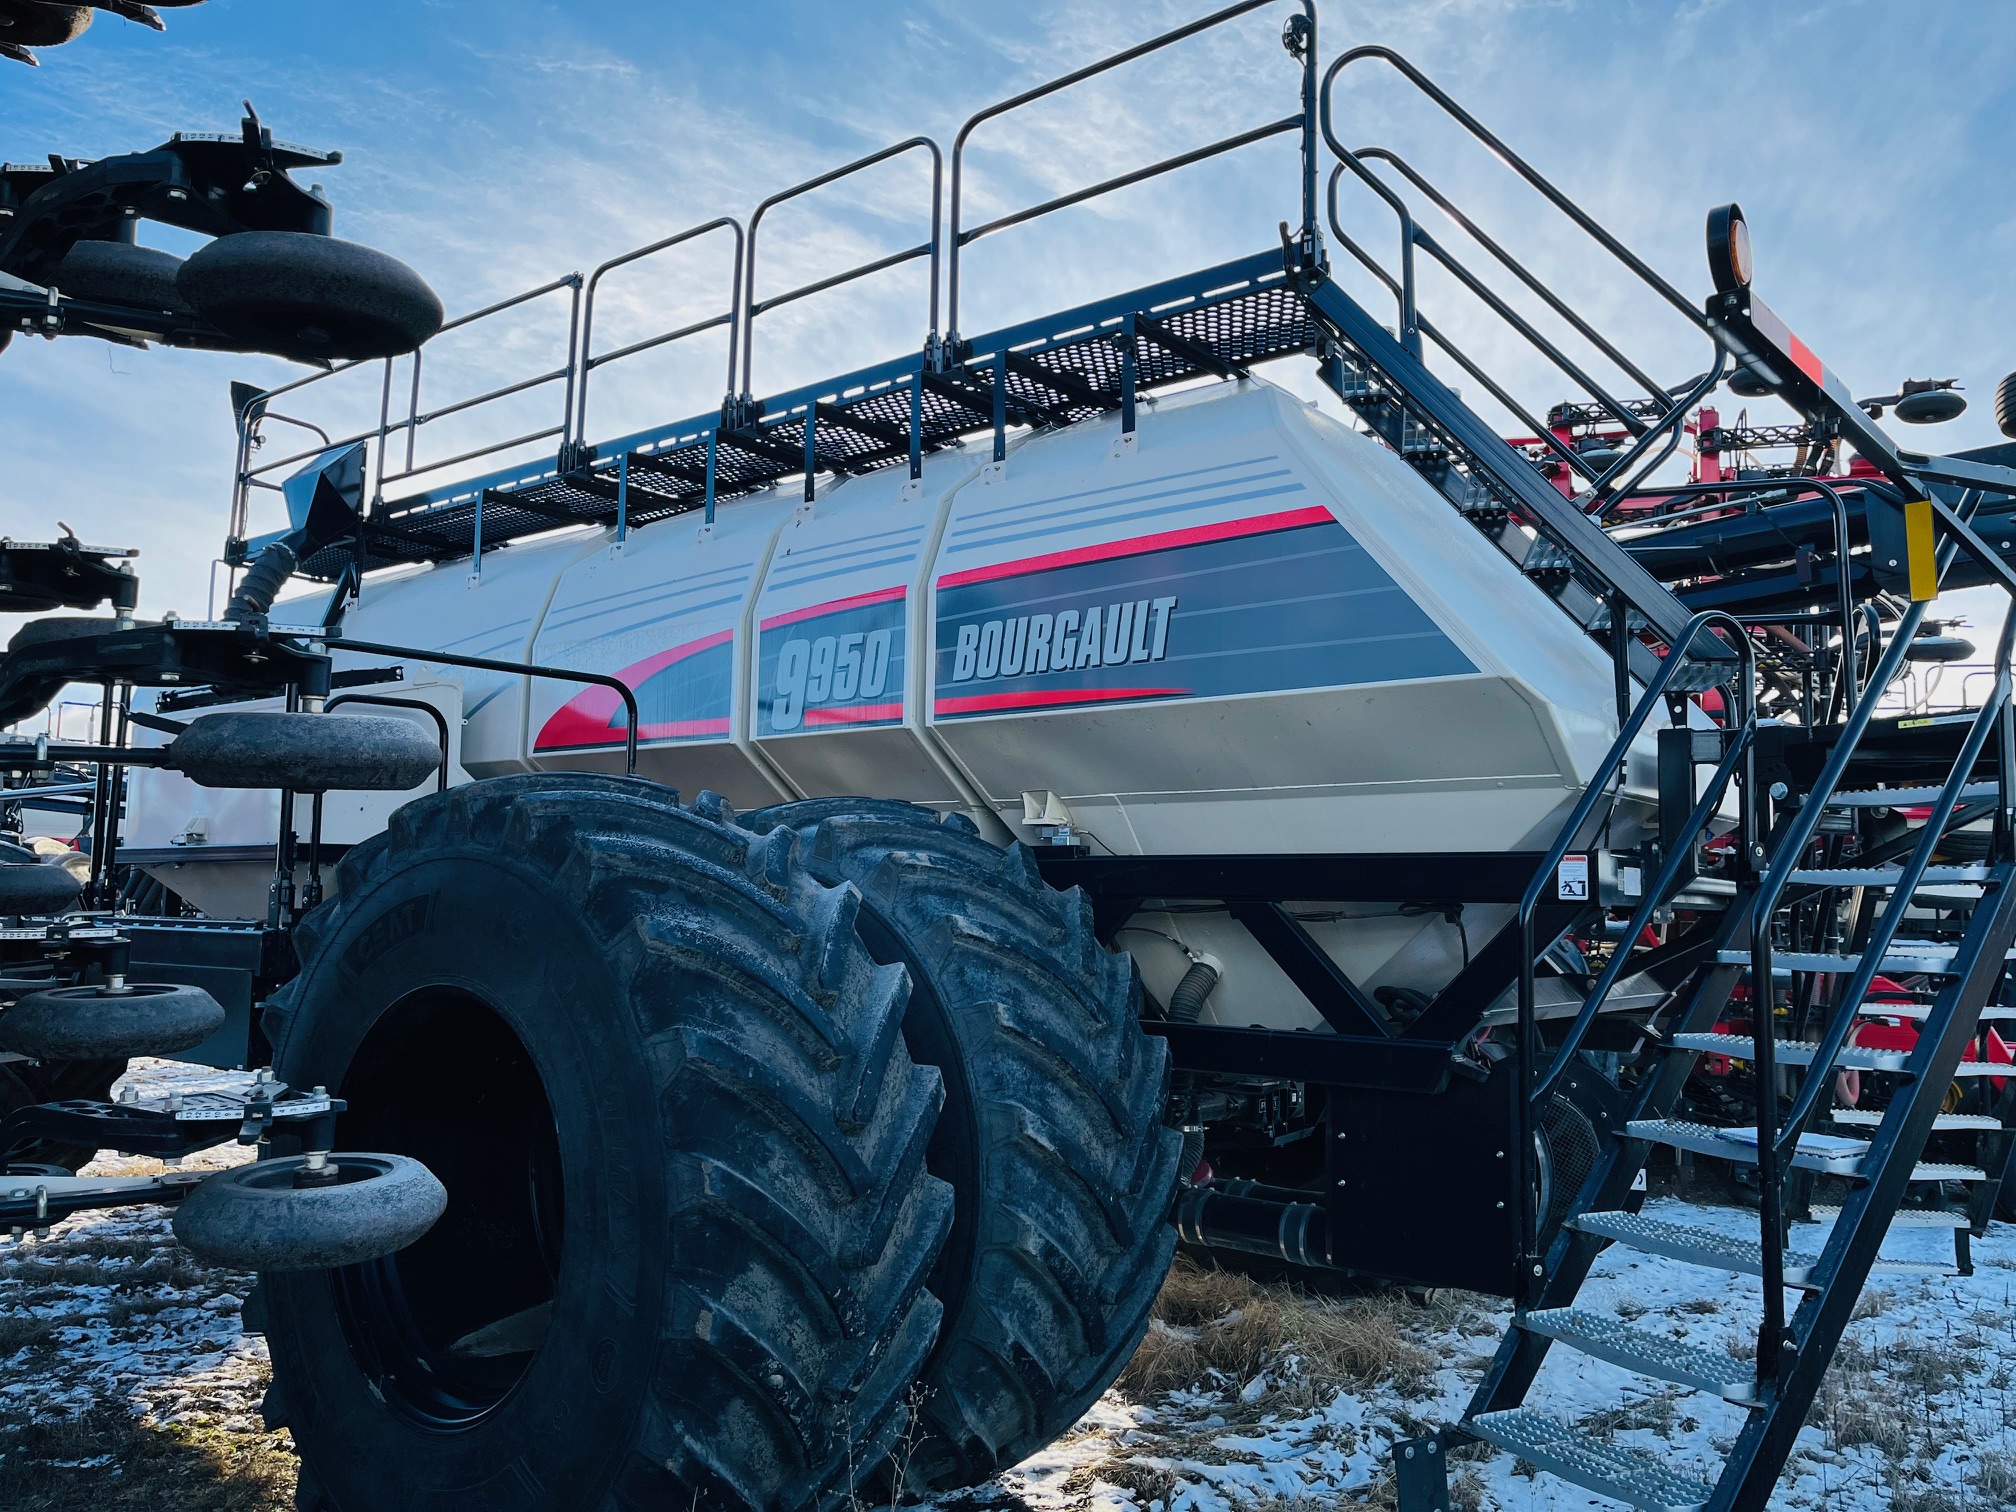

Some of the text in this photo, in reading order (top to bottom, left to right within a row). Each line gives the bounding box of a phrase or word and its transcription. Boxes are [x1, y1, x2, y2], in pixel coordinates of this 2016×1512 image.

[771, 628, 890, 731] 9950
[952, 595, 1178, 683] BOURGAULT
[357, 903, 415, 962] CEAT
